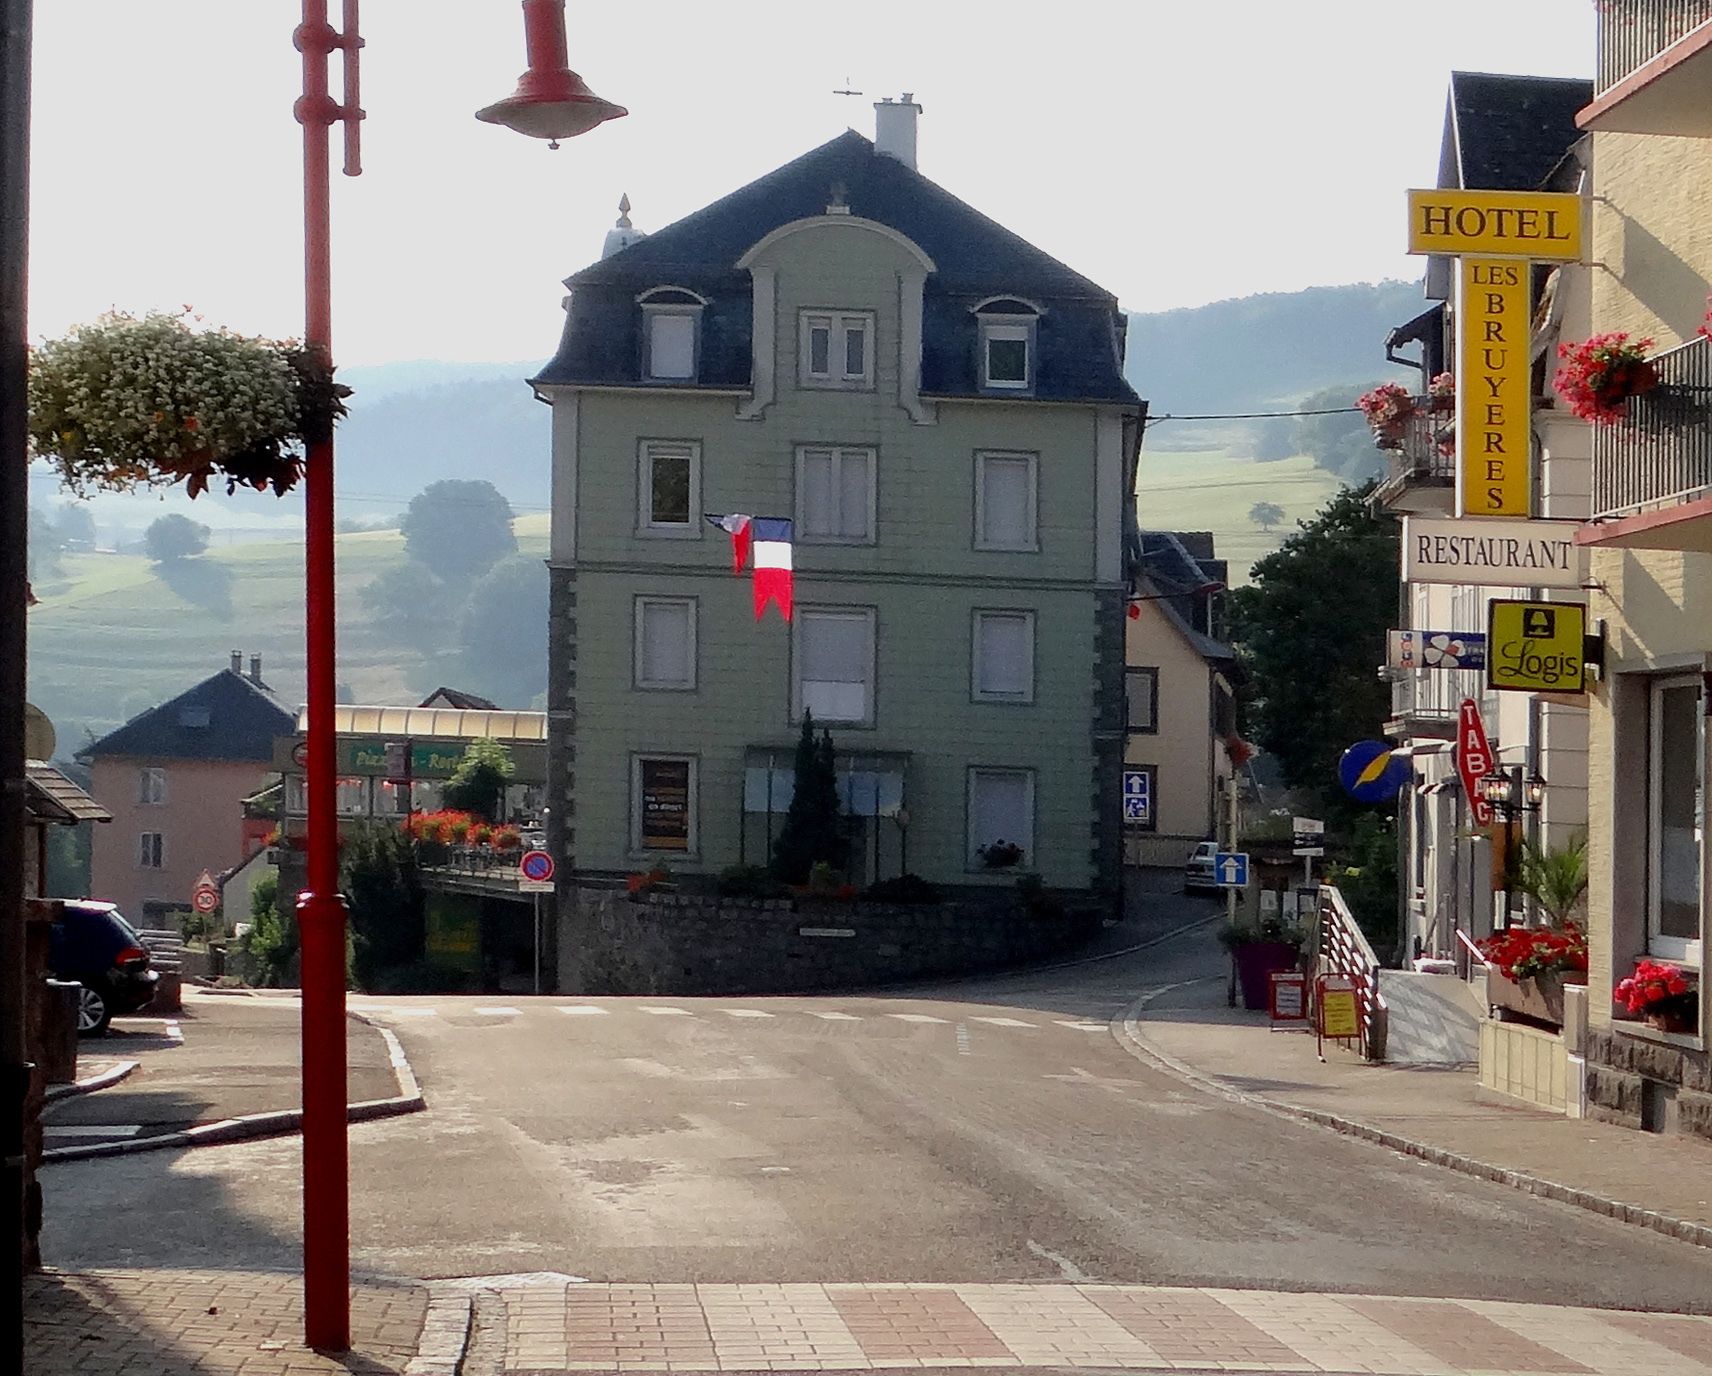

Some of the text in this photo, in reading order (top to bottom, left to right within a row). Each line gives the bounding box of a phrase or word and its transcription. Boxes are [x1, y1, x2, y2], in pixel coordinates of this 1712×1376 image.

[1420, 205, 1570, 241] HOTEL
[1472, 265, 1518, 286] LES
[1484, 293, 1507, 510] BRUYERES
[1417, 534, 1572, 570] RESTAURANT
[1497, 639, 1579, 684] Logis
